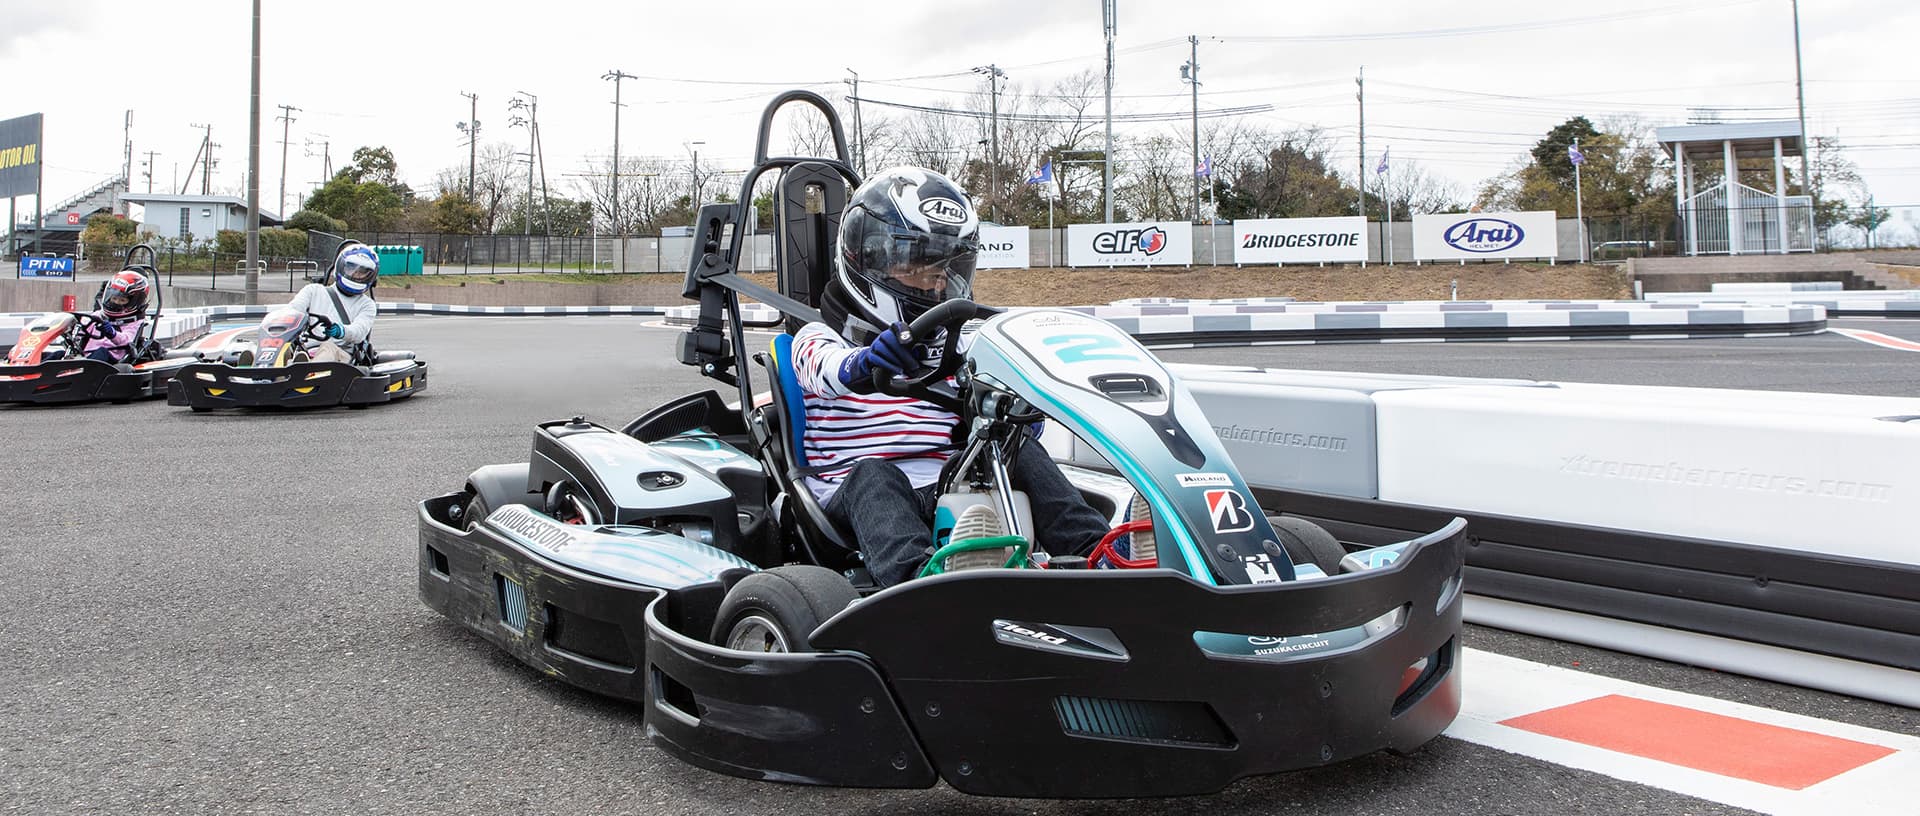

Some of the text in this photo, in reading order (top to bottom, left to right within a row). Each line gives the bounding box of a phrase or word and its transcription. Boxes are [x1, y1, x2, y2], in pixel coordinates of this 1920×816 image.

[0, 144, 36, 169] OTOR OIL
[923, 201, 964, 219] Arai
[1093, 229, 1141, 254] elf
[1242, 233, 1360, 249] BRIDGESTONE
[1450, 222, 1514, 243] Arai
[979, 243, 1014, 251] AND
[28, 259, 66, 270] PIT IN
[1042, 334, 1141, 364] 2
[1558, 455, 1893, 503] xtremebarriers.com
[492, 508, 576, 553] BRIDGESTONE
